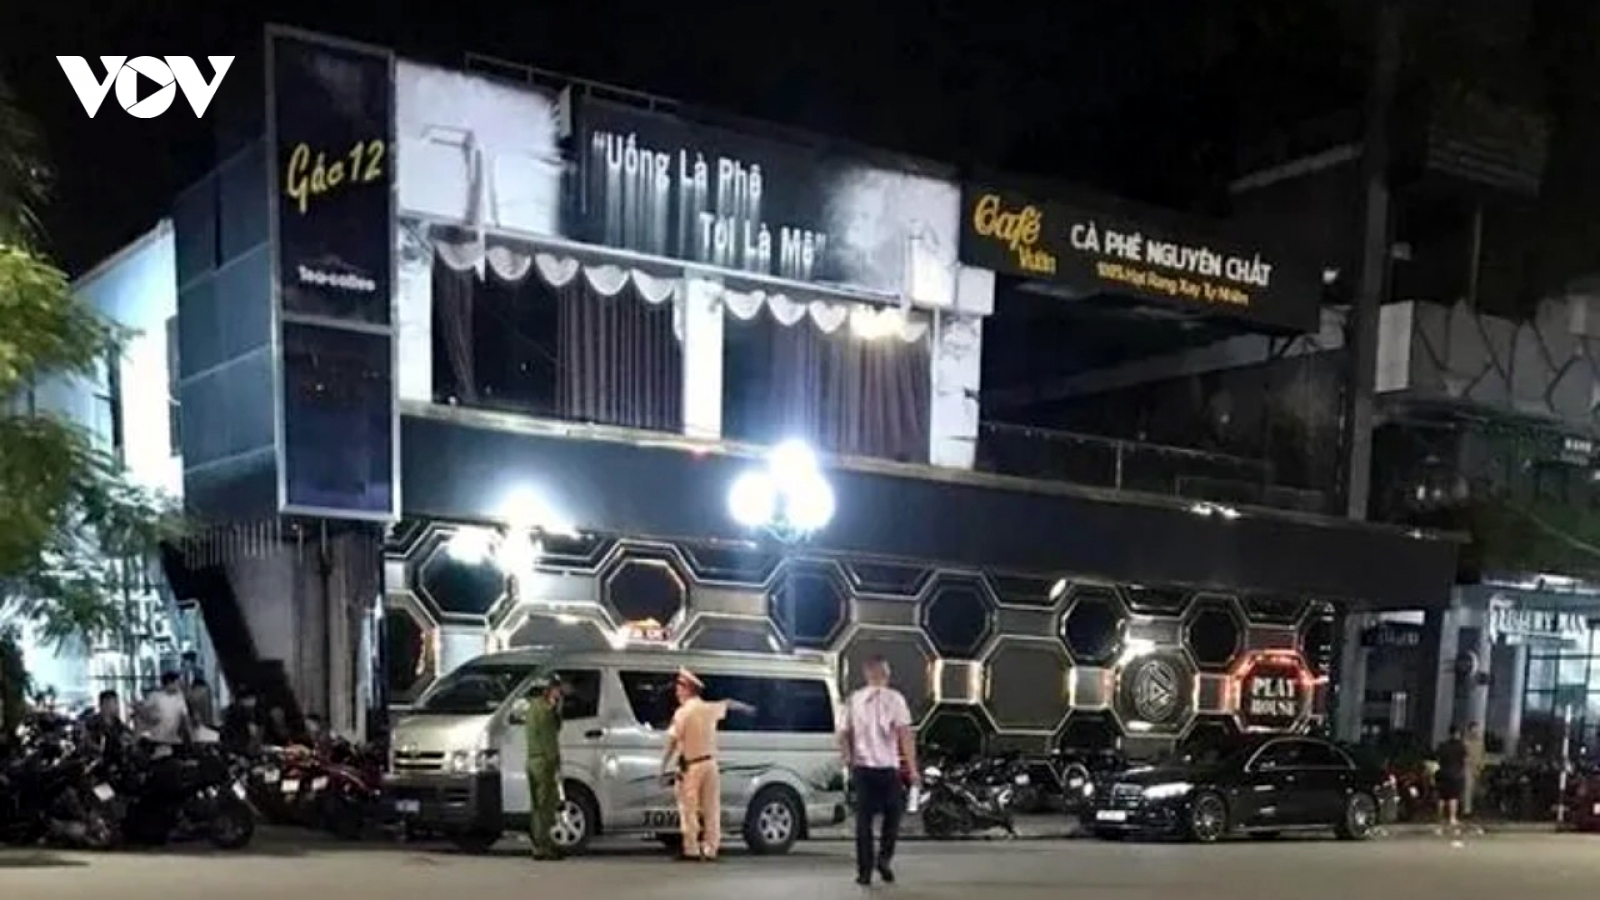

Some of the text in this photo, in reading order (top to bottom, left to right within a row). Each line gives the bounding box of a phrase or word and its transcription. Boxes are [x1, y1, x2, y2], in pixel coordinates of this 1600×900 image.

[349, 140, 384, 181] 12
[680, 149, 707, 187] Là
[719, 157, 761, 197] Phê
